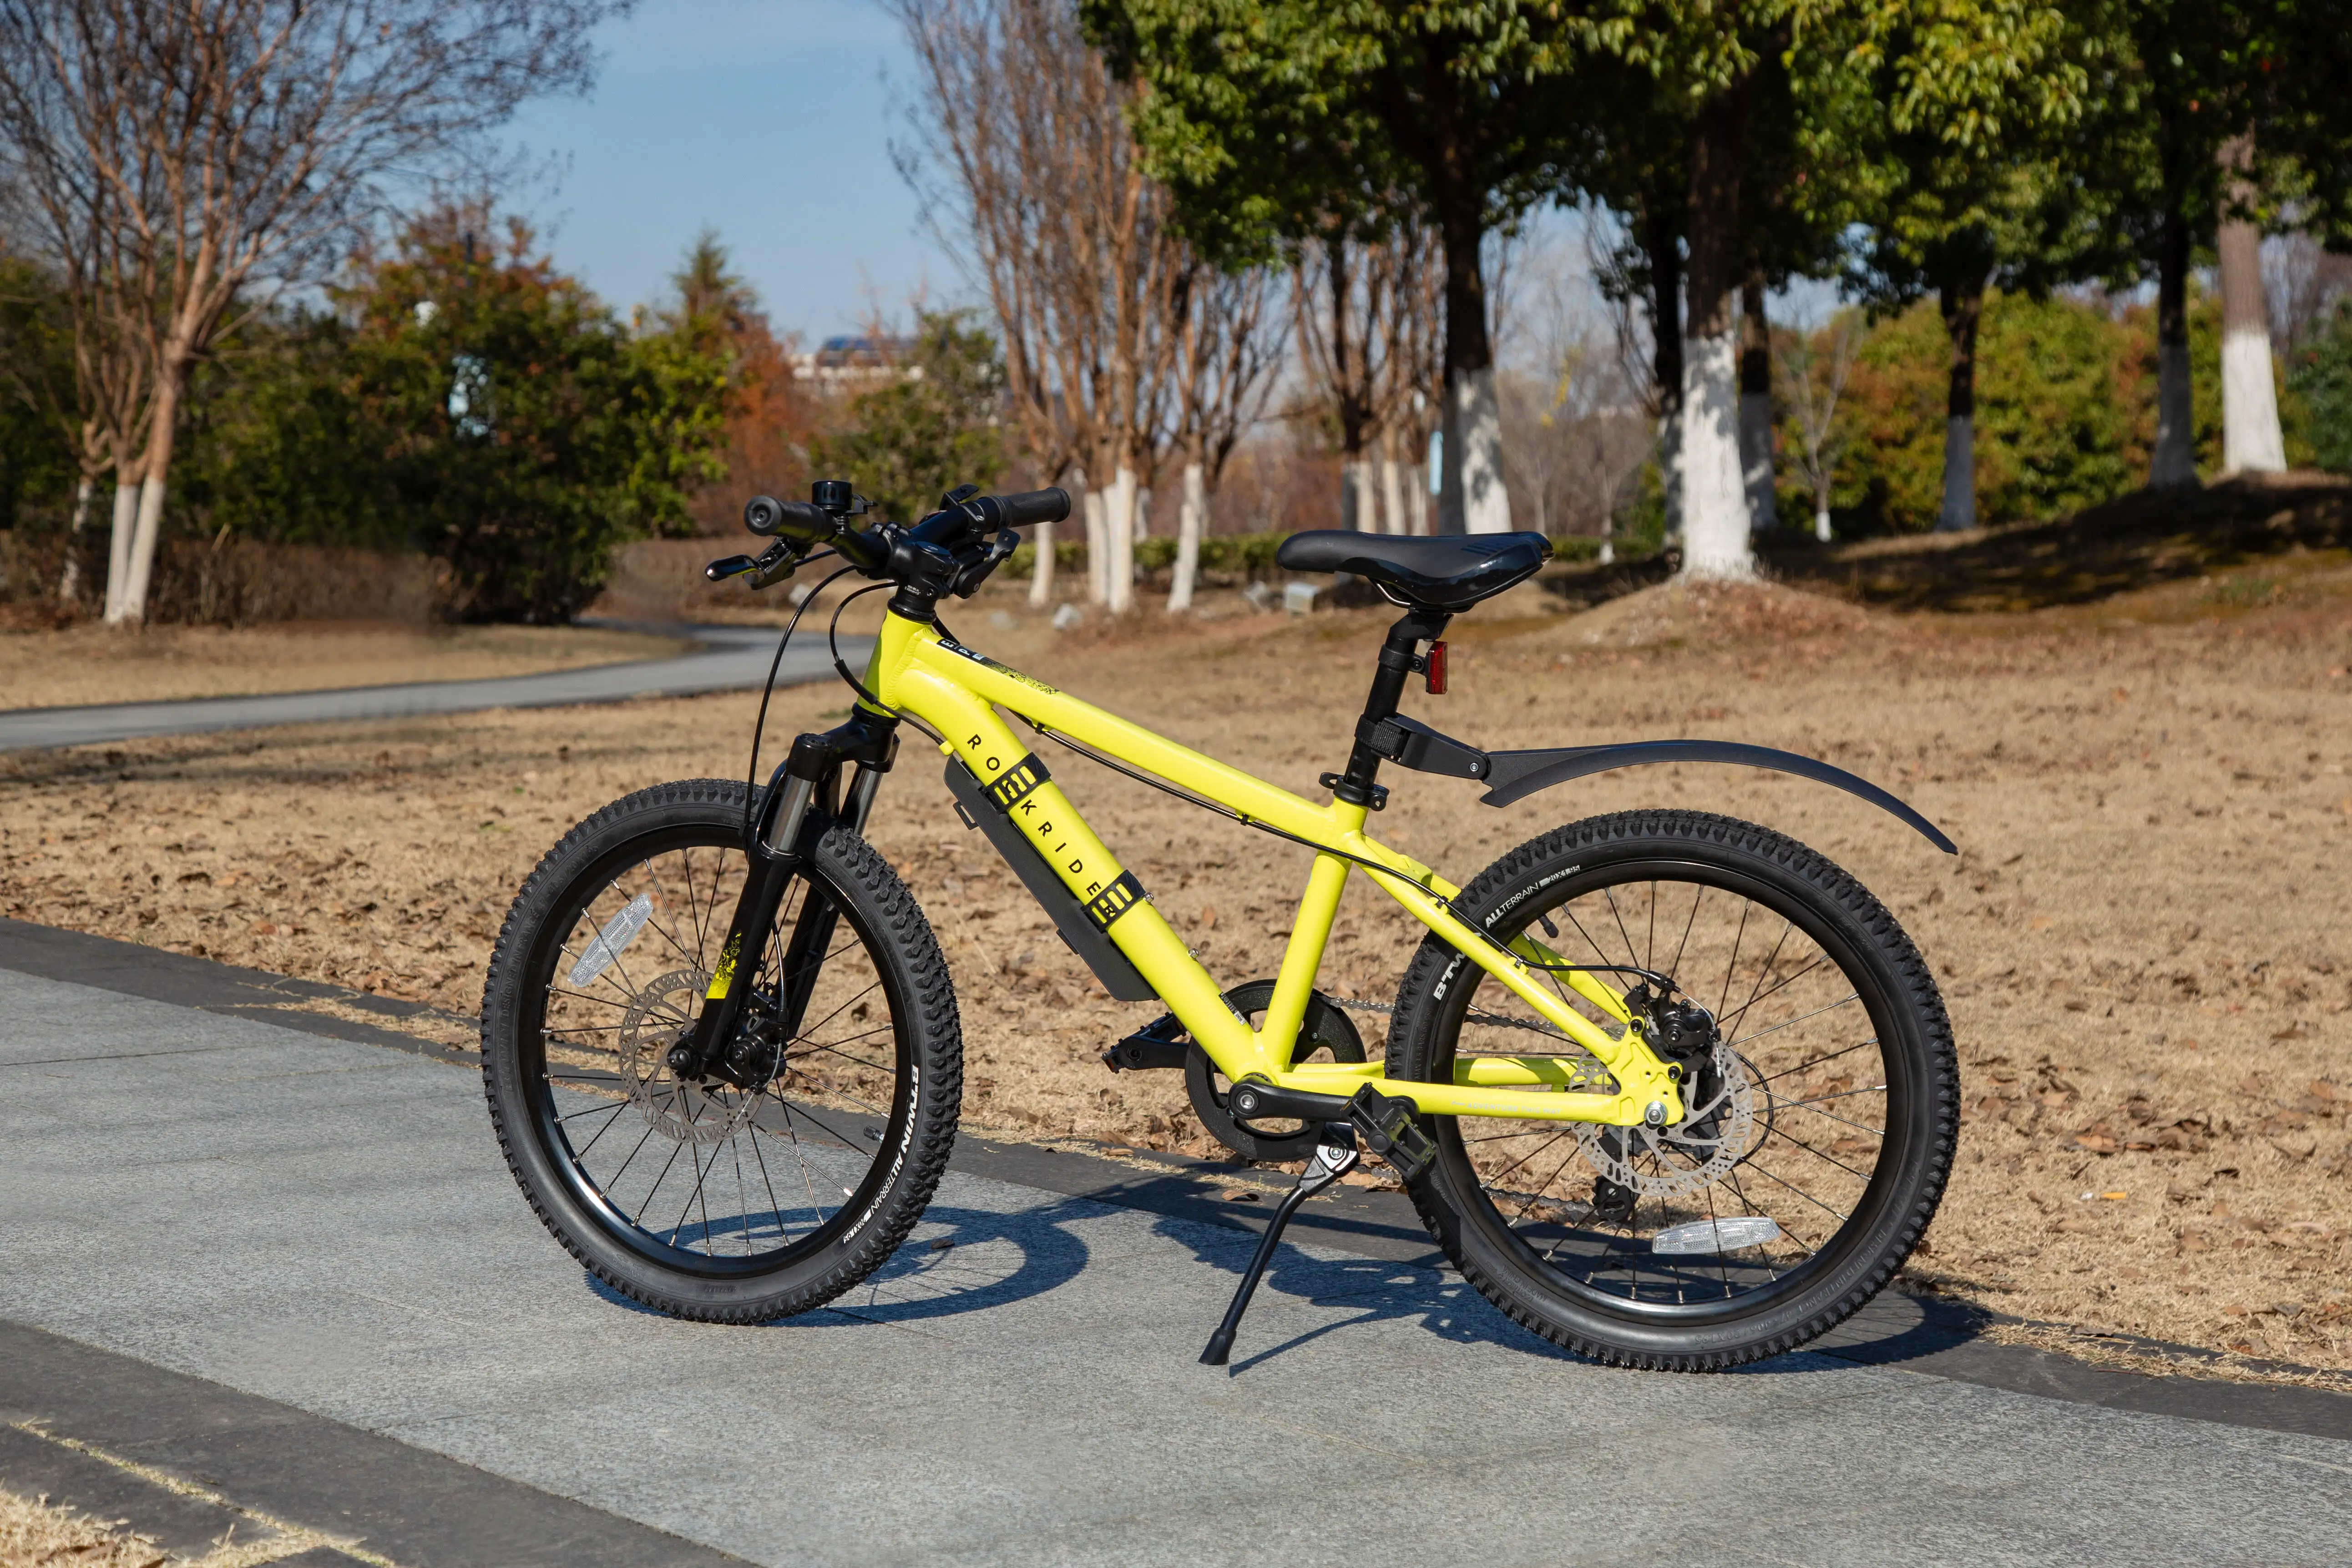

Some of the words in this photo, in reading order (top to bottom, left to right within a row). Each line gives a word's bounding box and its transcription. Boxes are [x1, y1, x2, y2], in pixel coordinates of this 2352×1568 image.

[1485, 882, 1539, 929] ALLTERRAIN
[900, 1064, 919, 1154] B'TWIN
[1467, 1102, 1519, 1112] ADVENTURE
[1521, 1106, 1540, 1114] THIS
[870, 1151, 903, 1214] ALLTERRAIN
